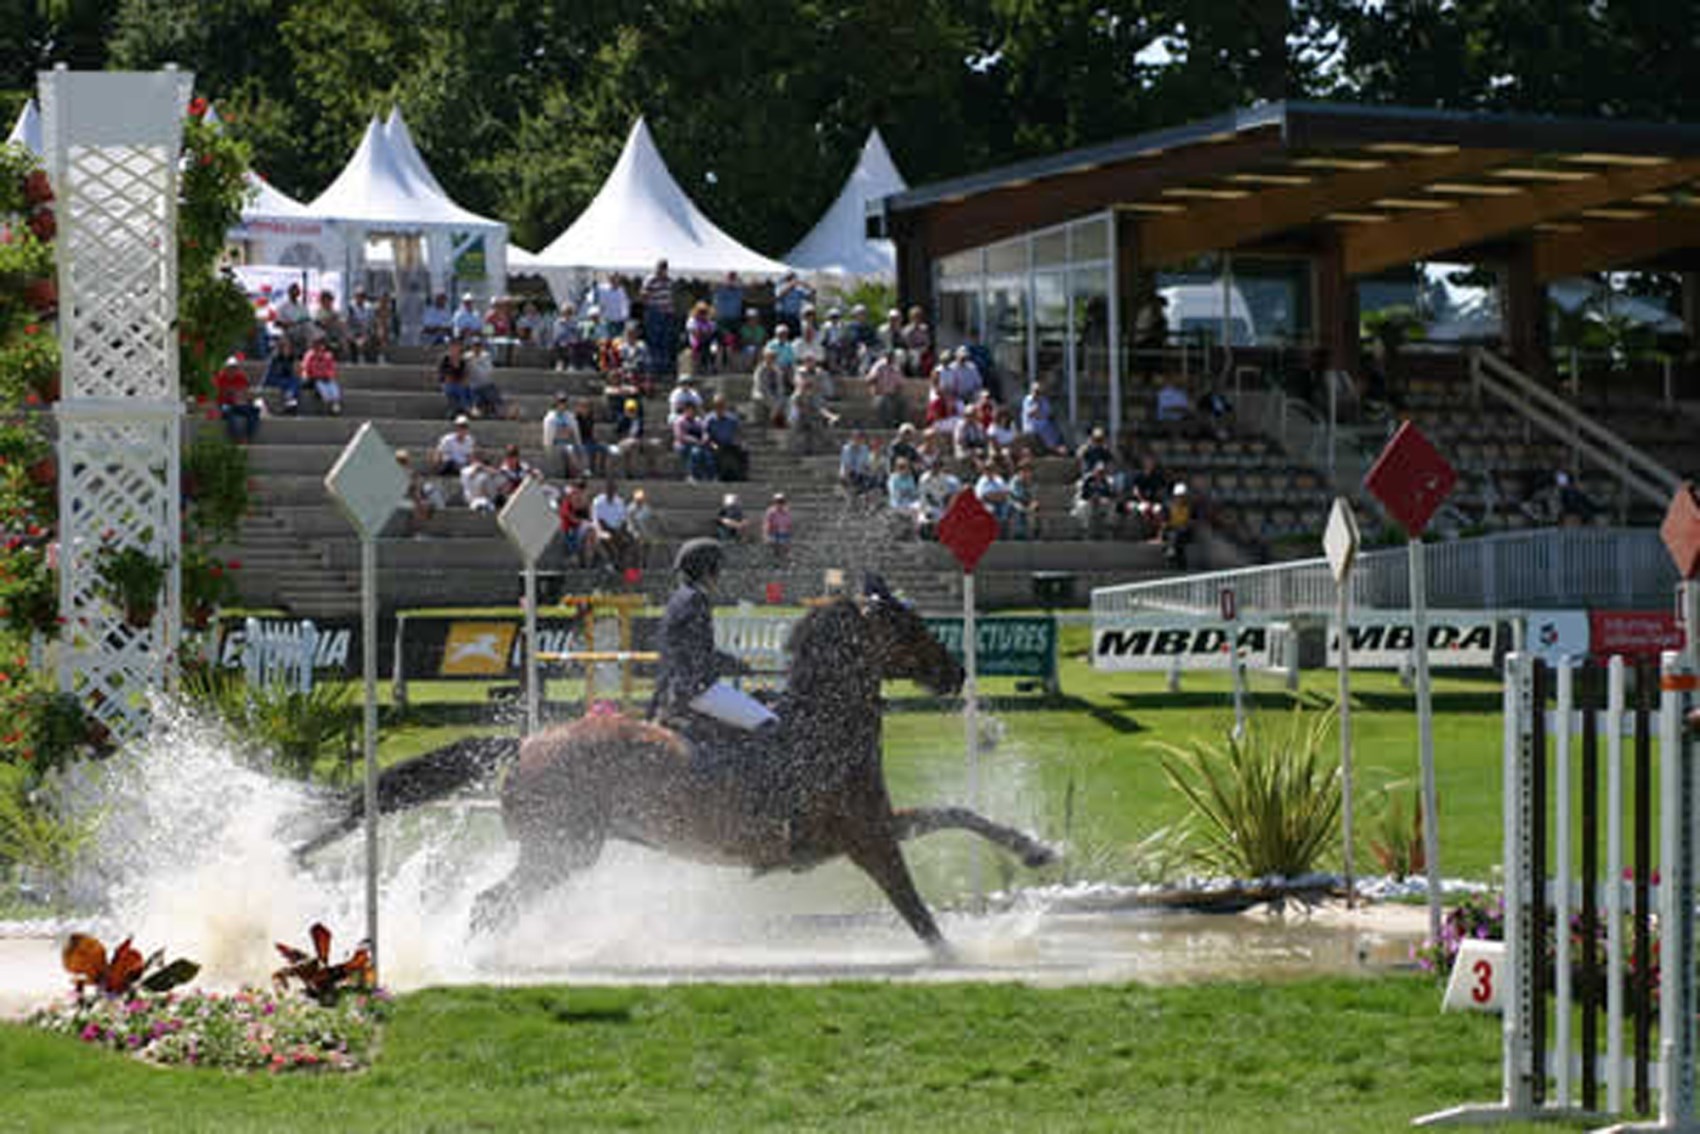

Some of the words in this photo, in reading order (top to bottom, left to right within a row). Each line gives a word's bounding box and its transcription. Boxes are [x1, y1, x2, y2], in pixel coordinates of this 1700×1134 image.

[928, 623, 1049, 651] TRCTURES
[1100, 627, 1266, 655] MBDA
[1333, 625, 1492, 650] MBDA
[1472, 960, 1493, 1004] 3
